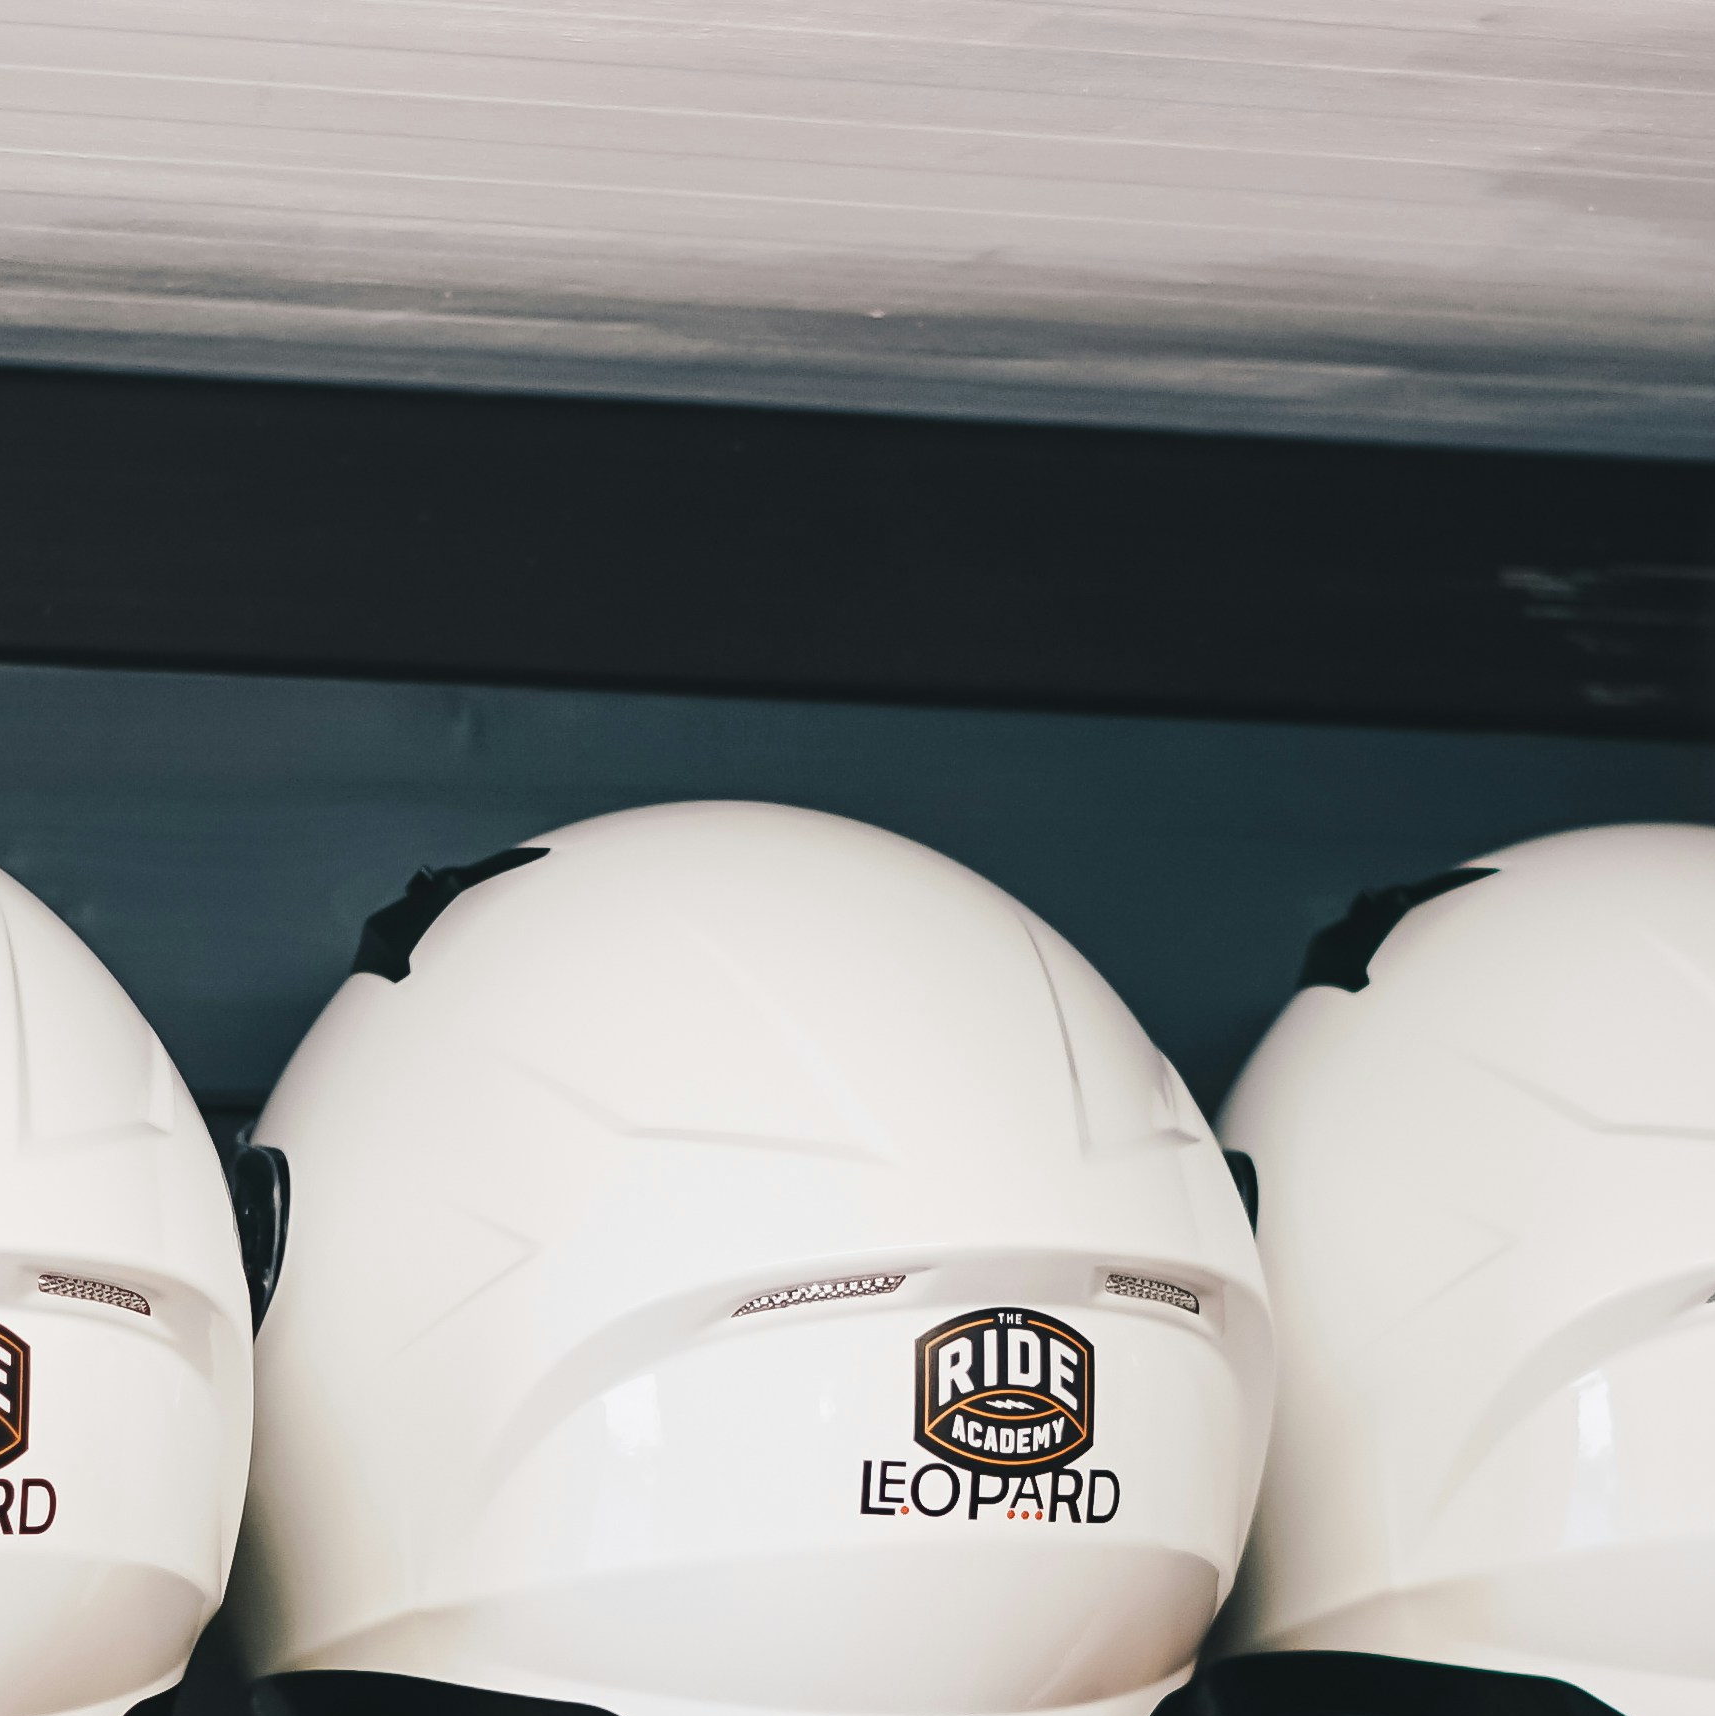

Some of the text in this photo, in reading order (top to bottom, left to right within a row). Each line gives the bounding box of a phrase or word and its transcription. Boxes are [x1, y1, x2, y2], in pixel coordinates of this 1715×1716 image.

[998, 1313, 1022, 1325] THE
[938, 1328, 1078, 1411] RIDE
[952, 1414, 1065, 1454] ACADEMY
[860, 1459, 1120, 1524] LEOPARD
